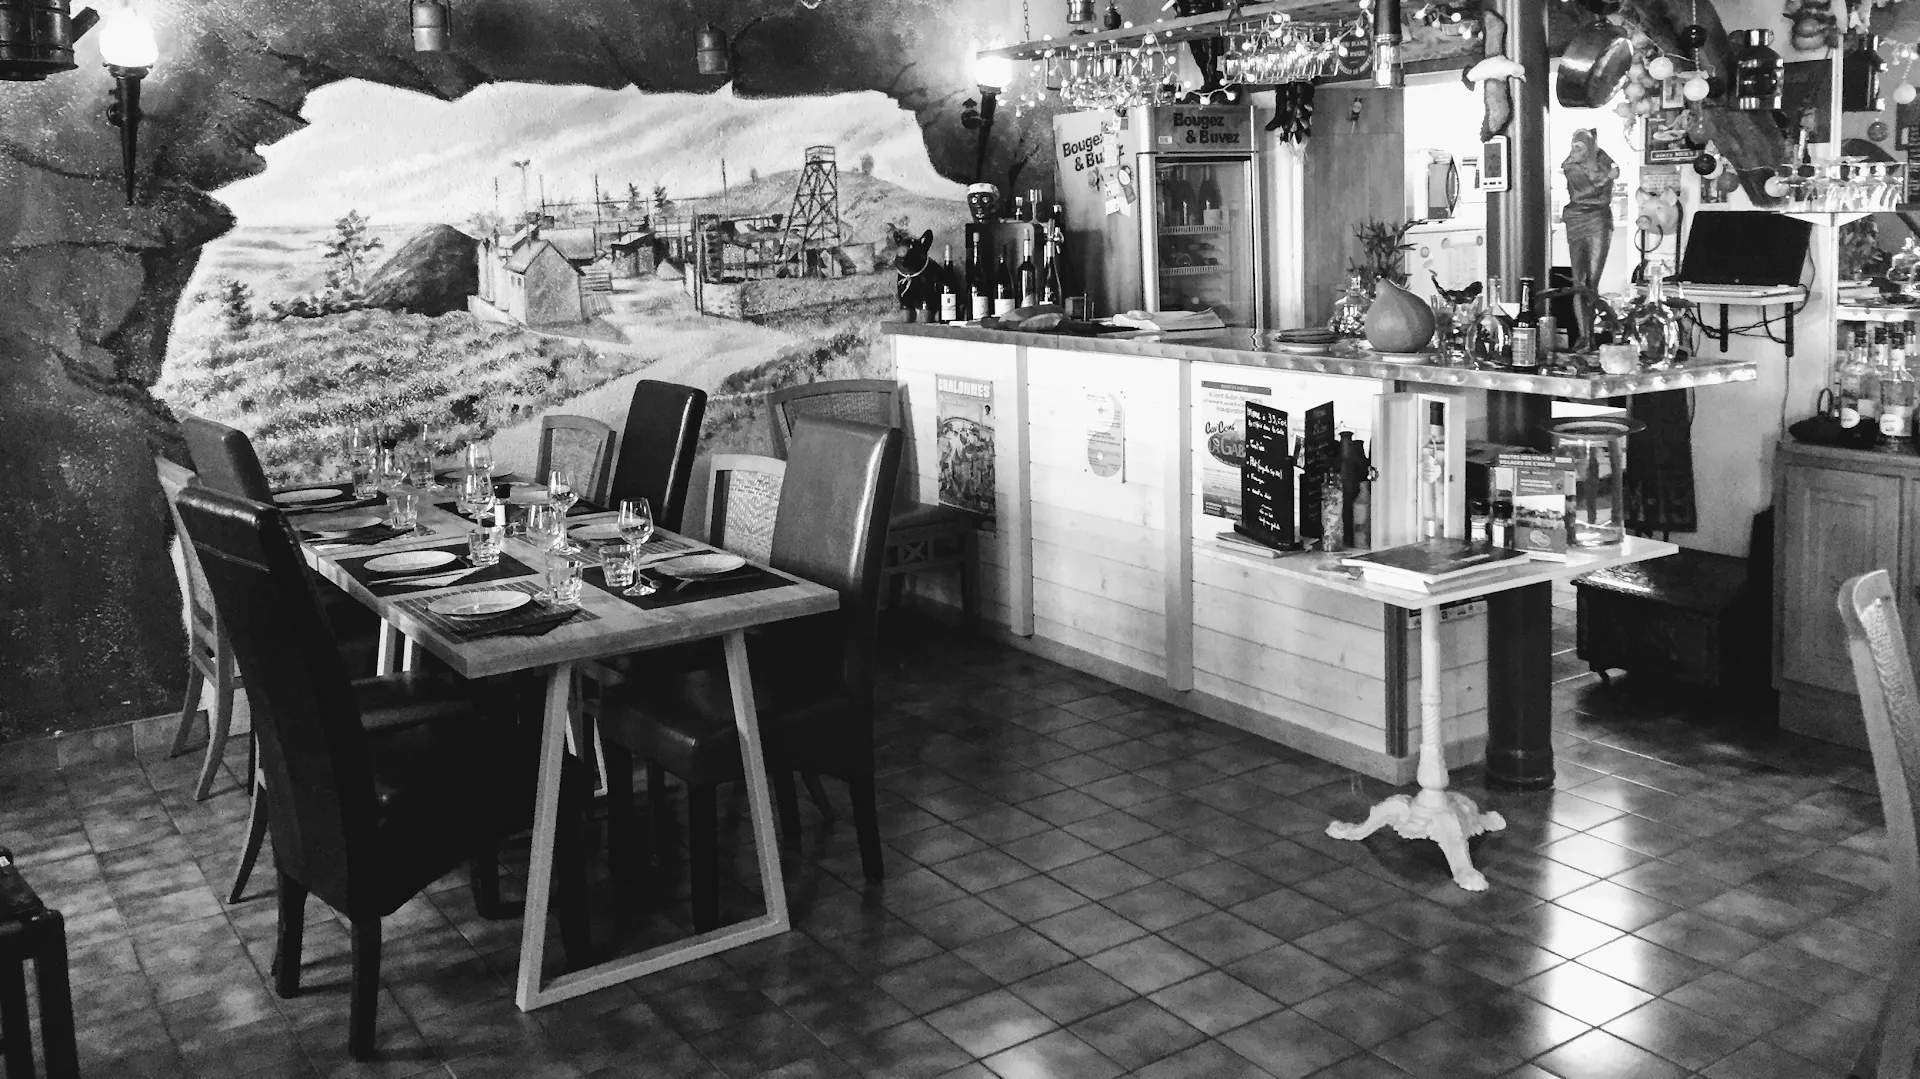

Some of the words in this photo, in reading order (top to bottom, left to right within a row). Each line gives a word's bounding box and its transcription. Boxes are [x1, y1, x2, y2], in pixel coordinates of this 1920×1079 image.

[1173, 112, 1225, 129] Bougez
[1185, 129, 1197, 144] &
[1199, 129, 1240, 144] Buvez
[1074, 156, 1085, 171] &
